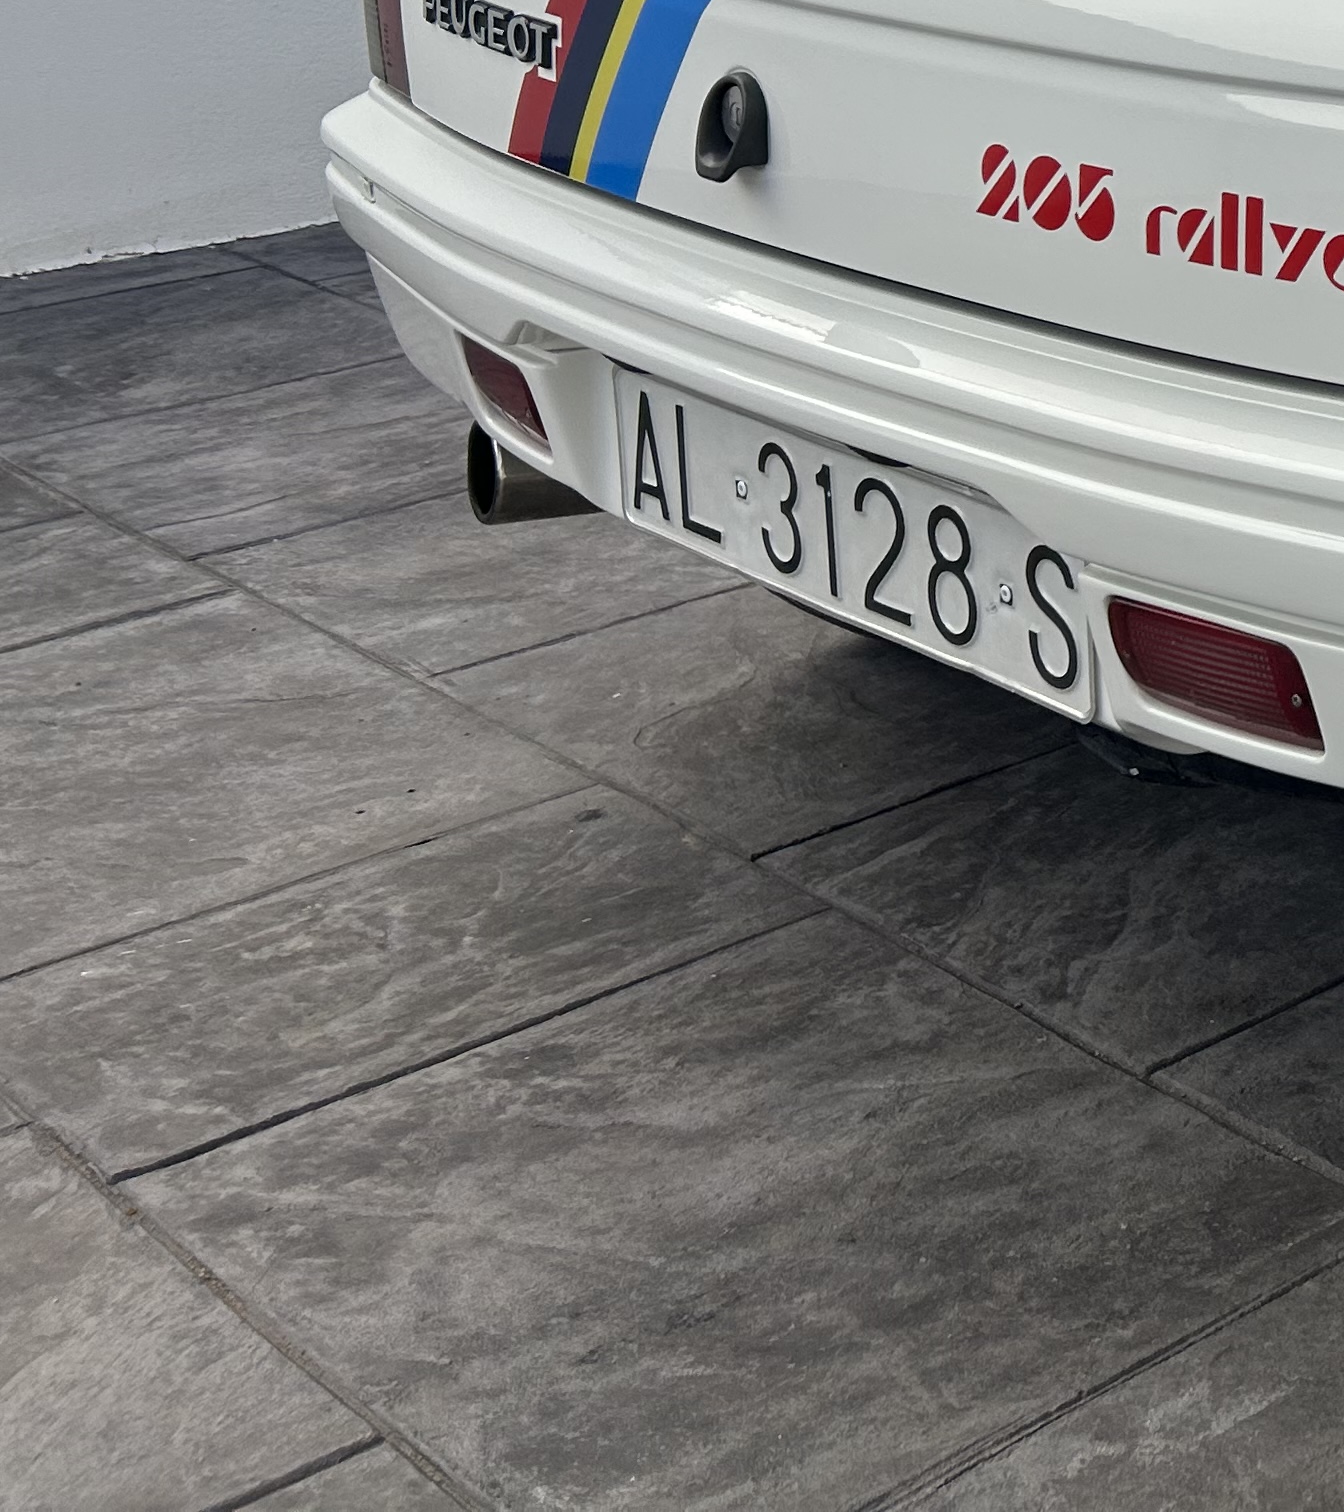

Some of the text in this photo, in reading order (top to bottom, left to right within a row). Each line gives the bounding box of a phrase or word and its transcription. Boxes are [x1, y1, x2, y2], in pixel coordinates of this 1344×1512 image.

[976, 143, 1116, 242] 205
[633, 390, 1079, 690] AL 3128 S
